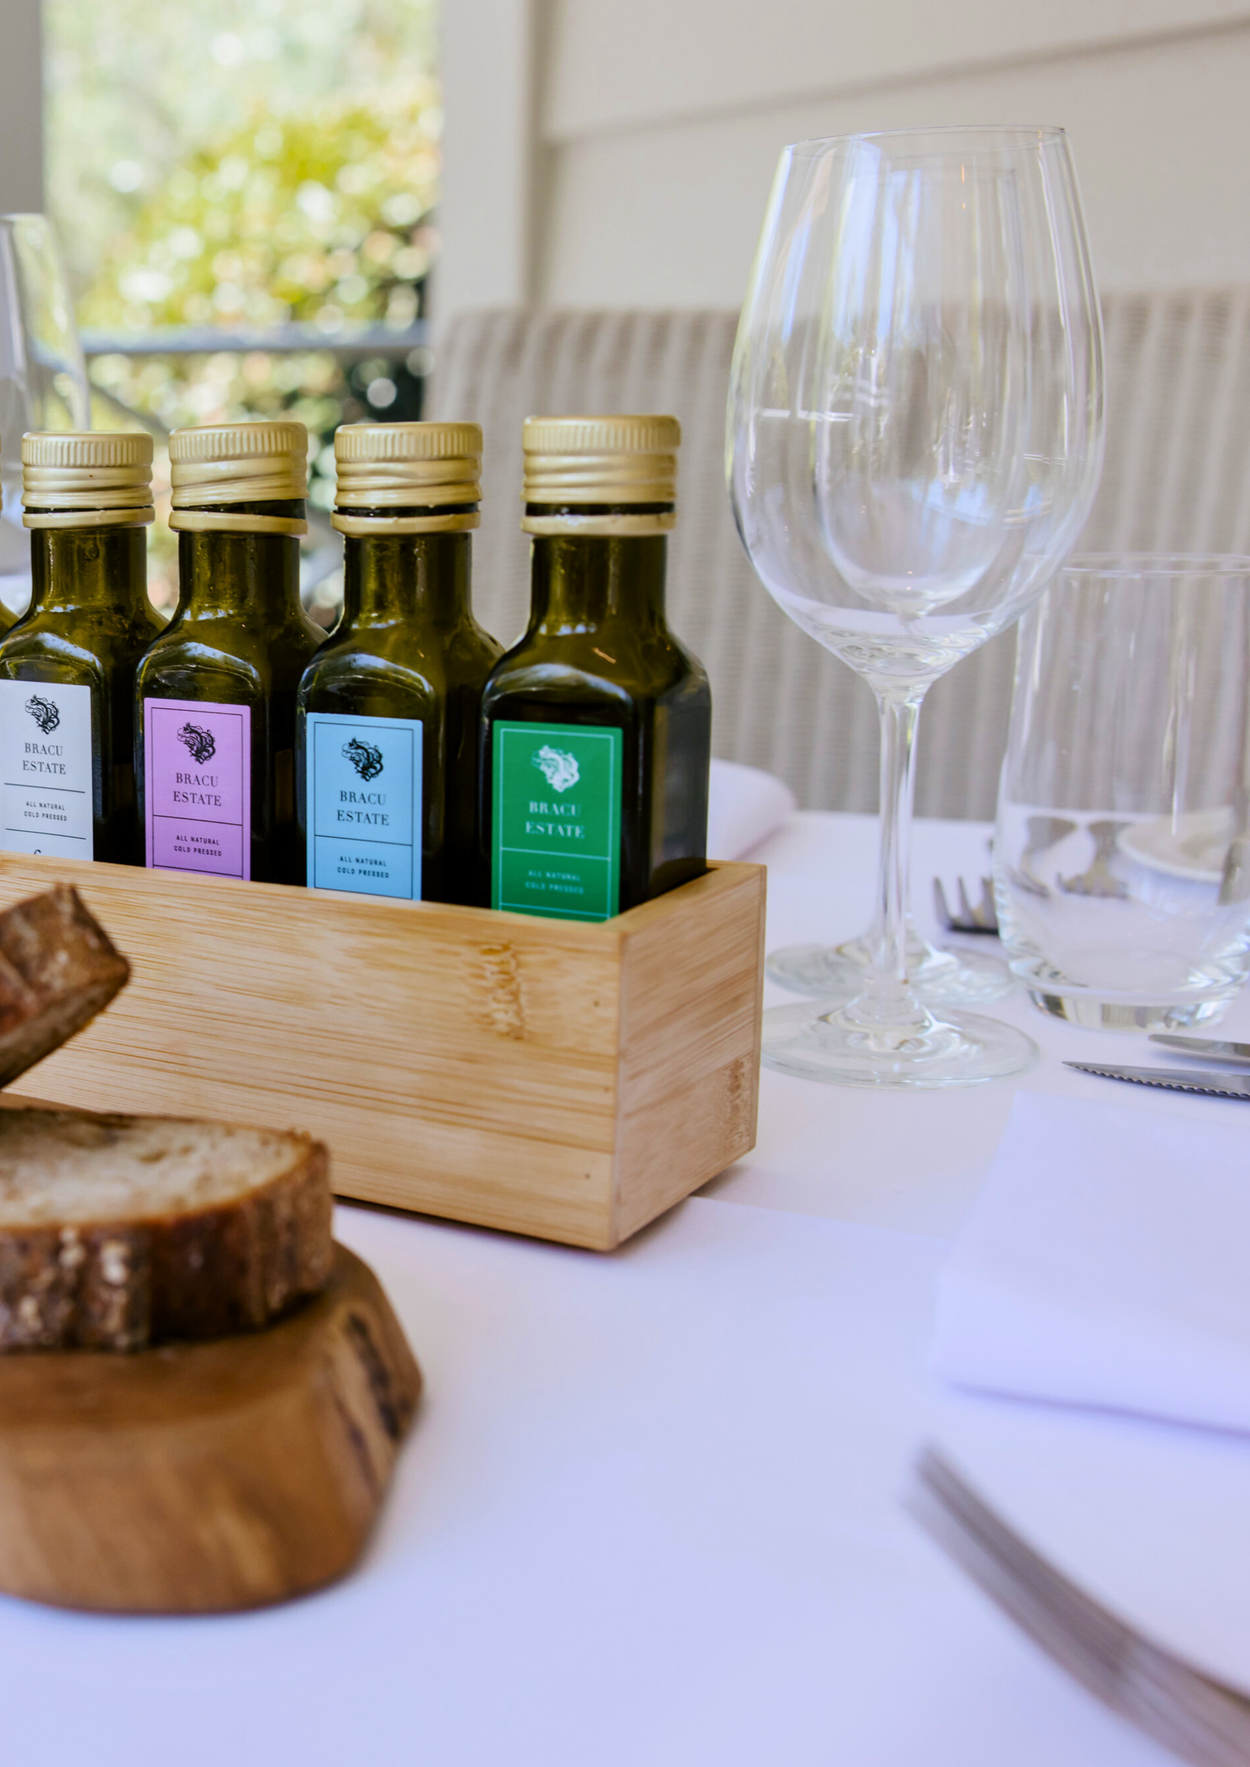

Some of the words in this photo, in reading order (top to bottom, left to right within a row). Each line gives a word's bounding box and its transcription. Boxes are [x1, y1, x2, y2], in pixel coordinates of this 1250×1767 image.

[25, 743, 63, 756] BRACU
[23, 760, 66, 774] ESTATE
[176, 773, 218, 787] BRACU
[174, 791, 221, 806] ESTATE
[340, 790, 386, 805] BRACU
[39, 802, 65, 810] NATURAL
[529, 801, 581, 816] BRACU
[42, 813, 67, 821] PRESSED
[337, 810, 389, 825] ESTATE
[526, 822, 585, 839] ESTATE
[191, 836, 219, 845] NATURAL
[194, 847, 222, 856] PRESSED
[356, 858, 386, 866] NATURAL
[359, 869, 389, 878] PRESSED
